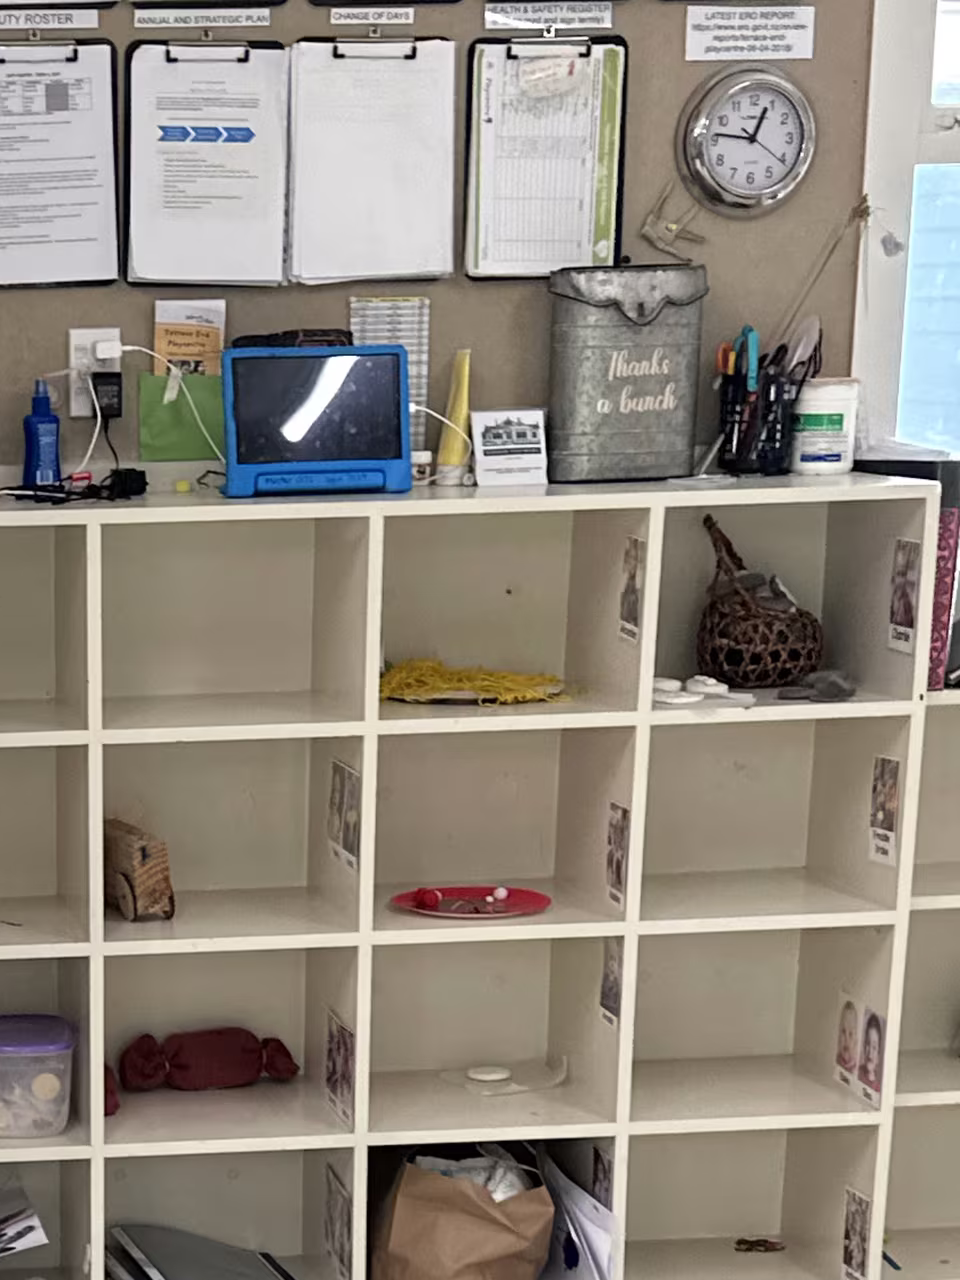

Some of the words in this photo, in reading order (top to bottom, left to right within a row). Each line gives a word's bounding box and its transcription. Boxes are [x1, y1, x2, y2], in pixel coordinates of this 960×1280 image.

[566, 3, 610, 13] REGISTER
[24, 13, 74, 25] ROSTER
[174, 15, 191, 25] AND
[192, 15, 242, 25] STRATEGIC
[245, 15, 270, 24] PLAN
[332, 11, 370, 21] CHANGE
[372, 12, 385, 21] OF
[387, 11, 411, 21] DAYS
[704, 11, 737, 21] LATEST
[731, 100, 741, 113] 11
[748, 94, 760, 107] 12
[768, 99, 776, 112] 1
[717, 114, 730, 128] 10
[779, 112, 790, 126] 2
[784, 131, 795, 145] 3
[715, 153, 725, 167] 8
[729, 167, 738, 180] 7
[745, 171, 756, 185] 6
[764, 165, 774, 179] 5
[607, 346, 670, 381] Thanks
[596, 398, 614, 414] a
[619, 382, 678, 414] bunch
